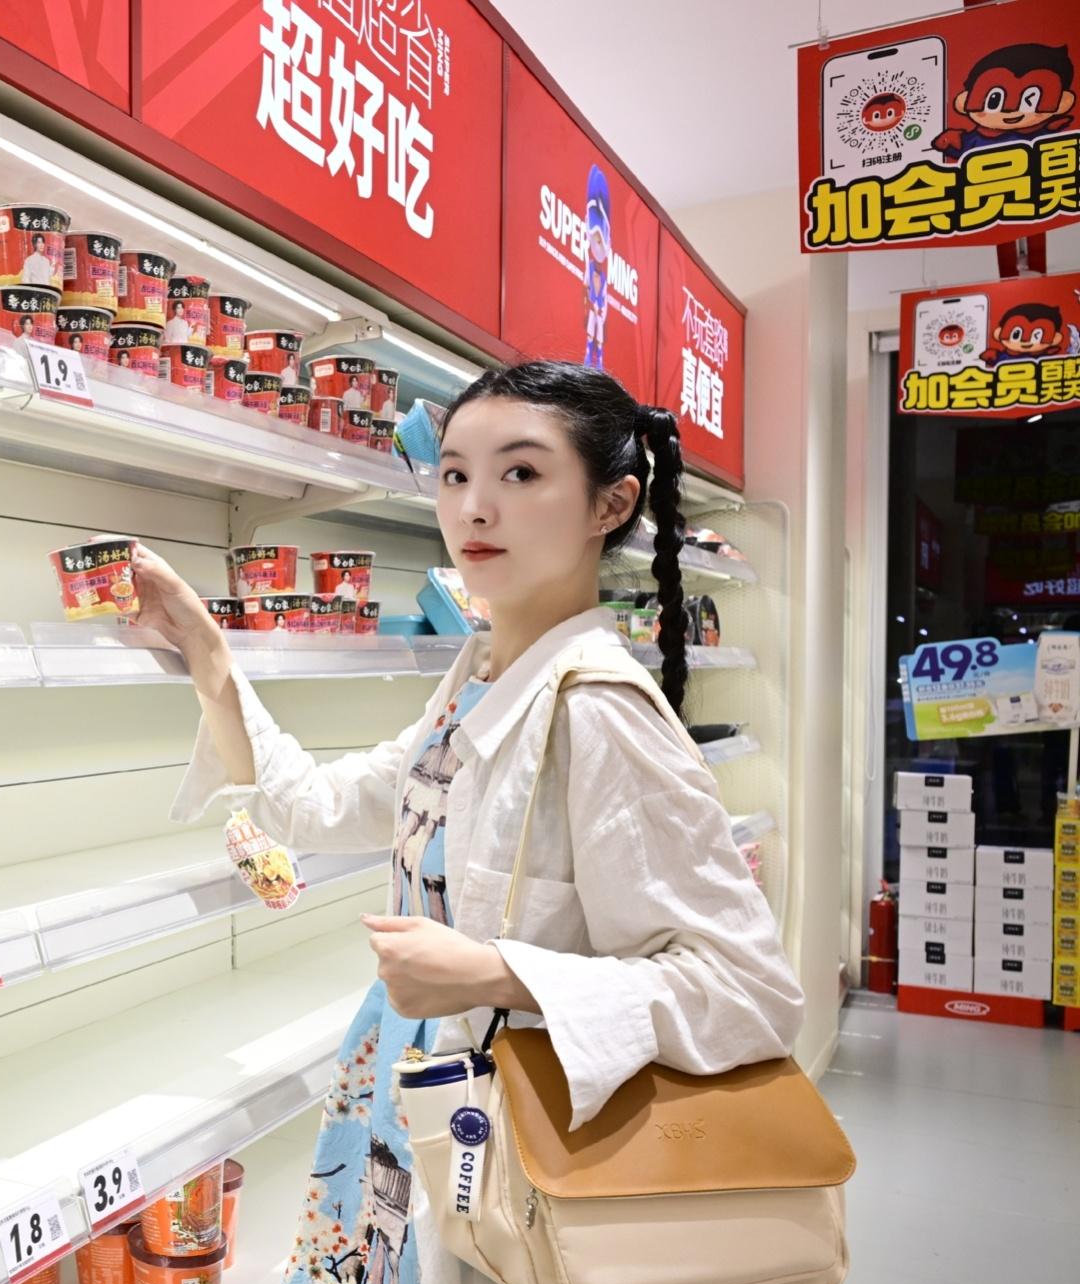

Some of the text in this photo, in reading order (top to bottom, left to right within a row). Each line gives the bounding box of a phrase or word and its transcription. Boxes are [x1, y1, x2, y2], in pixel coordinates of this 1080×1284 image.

[256, 0, 436, 239] 超好吃
[861, 152, 903, 168] 扫码注册
[1039, 138, 1080, 178] 百
[811, 148, 1036, 246] 加会员
[1038, 175, 1080, 215] 天
[539, 184, 591, 262] SUPER
[607, 248, 638, 306] MING
[40, 353, 69, 387] 1.9
[680, 346, 724, 441] 真便宜
[904, 362, 1039, 410] 加会员
[912, 640, 999, 682] 49.8
[93, 1165, 123, 1213] 3.9
[456, 1151, 476, 1214] COFFEE
[9, 1212, 43, 1264] 1.8
